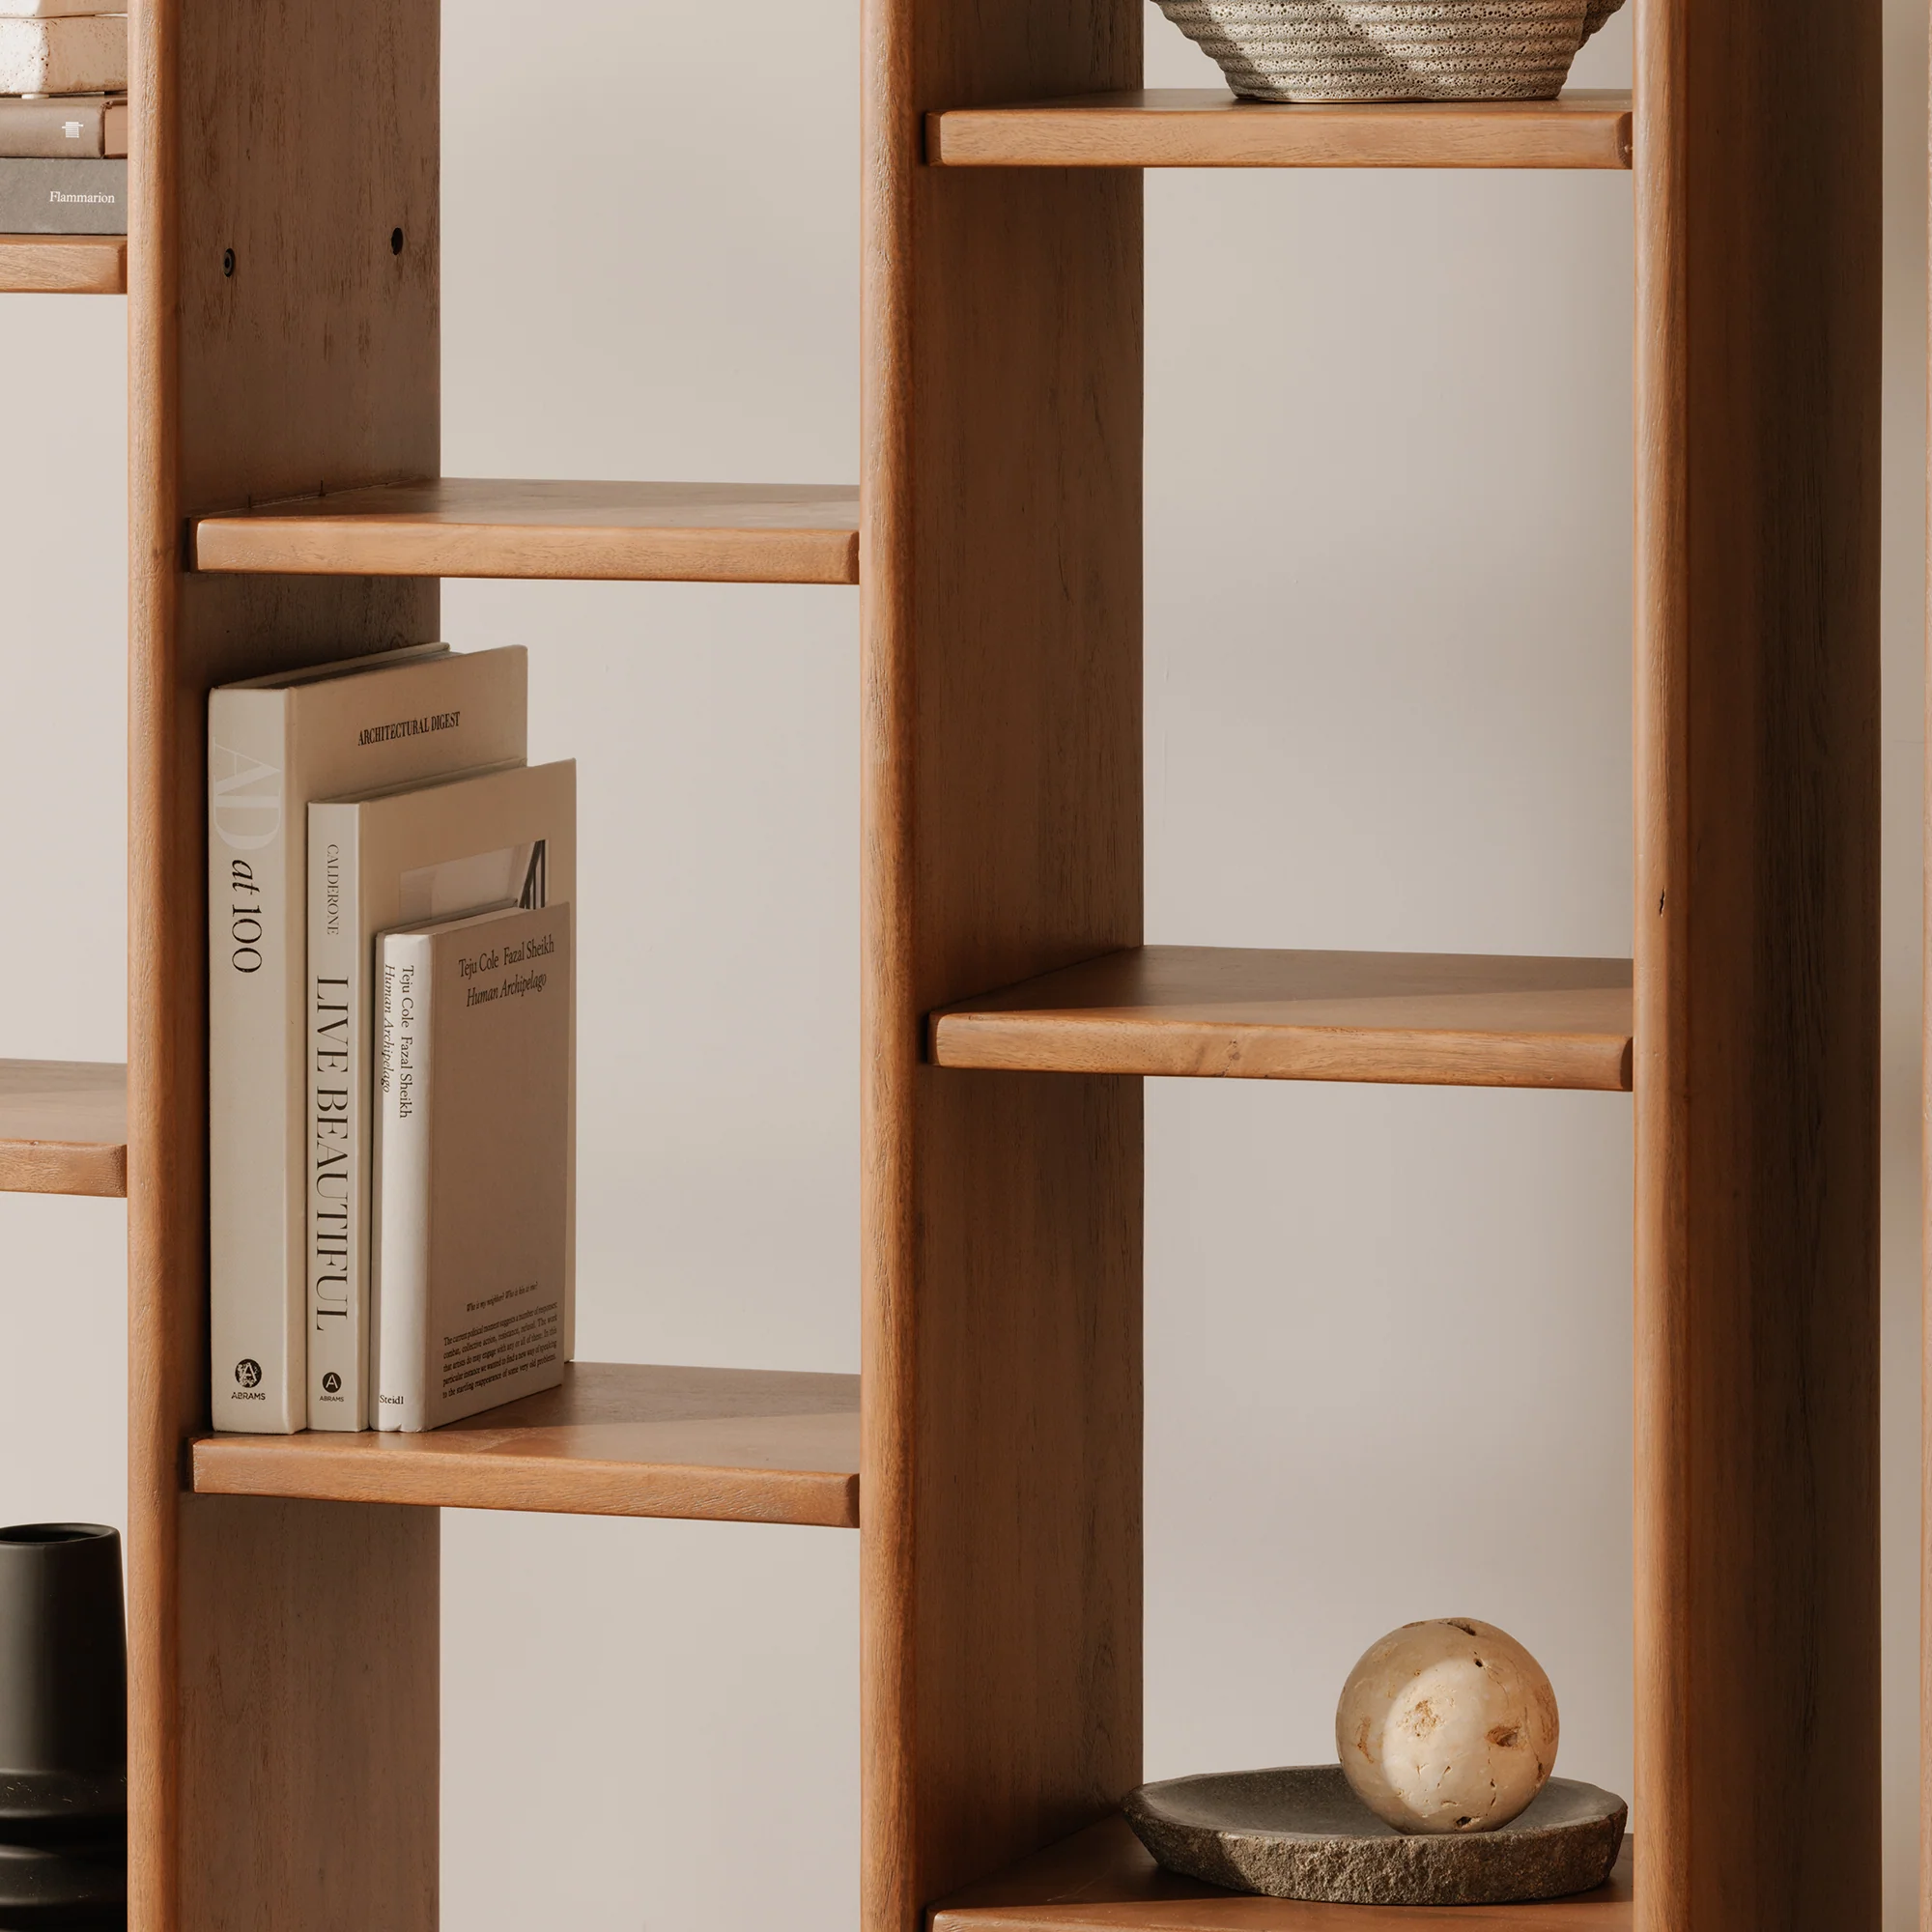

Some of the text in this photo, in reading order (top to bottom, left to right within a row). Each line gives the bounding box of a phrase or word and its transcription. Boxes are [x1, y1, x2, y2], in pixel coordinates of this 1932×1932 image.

[49, 190, 115, 204] Flammarion
[357, 711, 460, 746] ARCHITECTURAL DIGEST
[213, 736, 281, 973] AD at 100
[327, 843, 339, 935] CALDERONE
[458, 933, 554, 980] Teju Cole Fazal Sheikh
[467, 969, 547, 1007] Human Archipelago
[380, 964, 395, 1094] Human Archipelago
[399, 965, 414, 1119] Teju Cole Fazal Sheikh
[316, 975, 349, 1332] LIVE BEAUTIFUL
[231, 1391, 267, 1402] ABRAMS
[379, 1394, 404, 1406] Steidl
